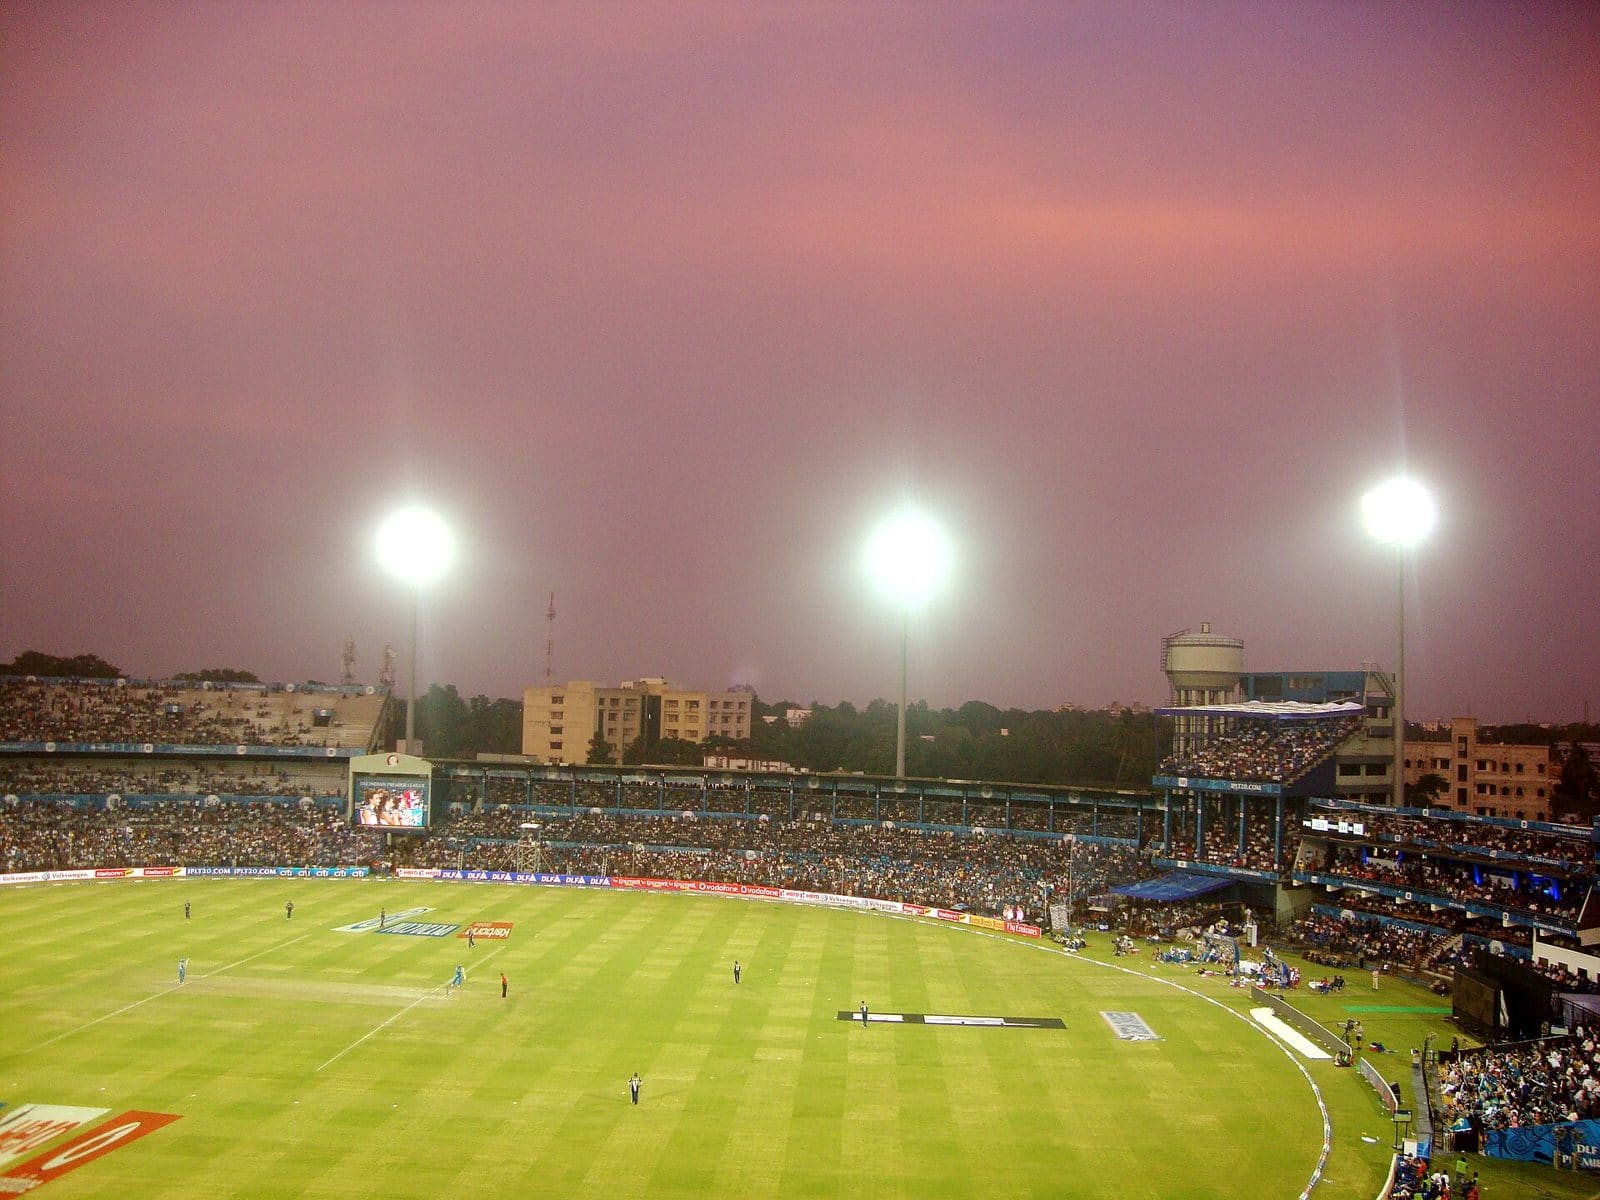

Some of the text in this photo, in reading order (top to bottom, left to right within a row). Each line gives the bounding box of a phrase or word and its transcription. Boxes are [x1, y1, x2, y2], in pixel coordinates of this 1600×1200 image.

[706, 884, 738, 892] vodafone
[748, 887, 779, 897] vodafone
[1007, 923, 1038, 936] Fly Emirates
[1577, 1144, 1598, 1155] DLF
